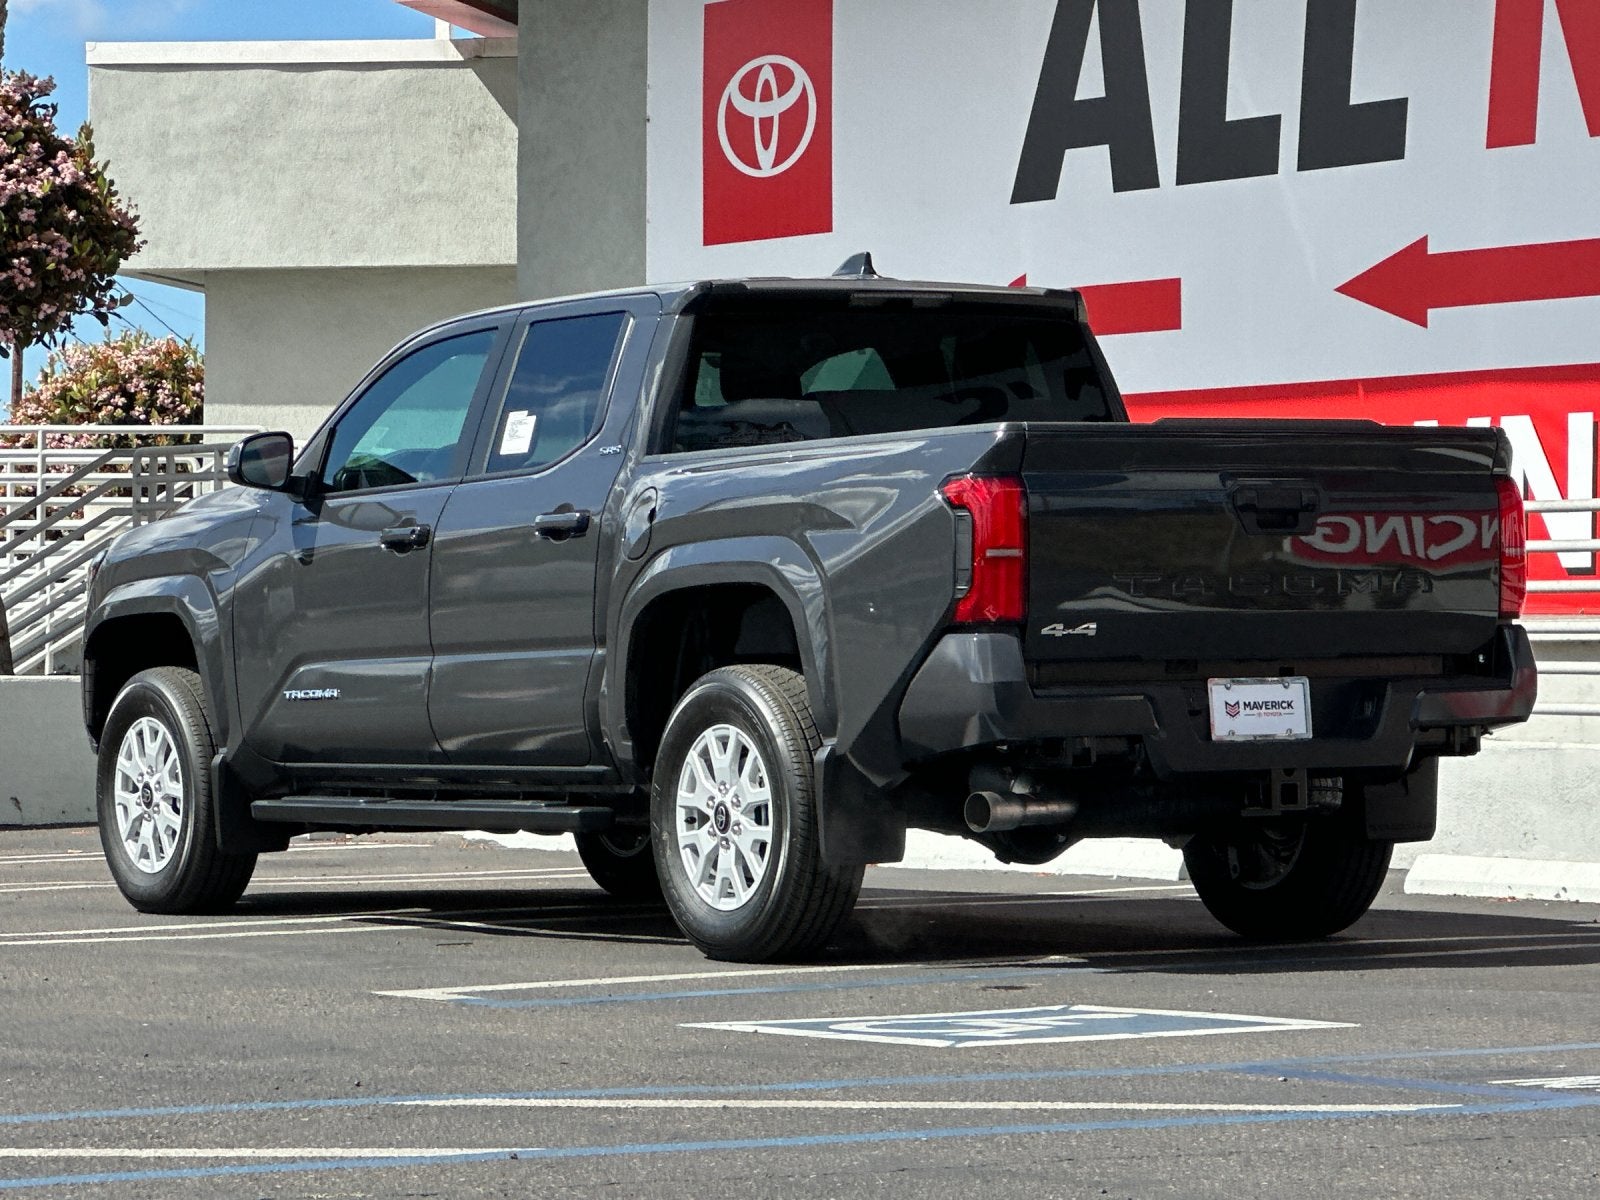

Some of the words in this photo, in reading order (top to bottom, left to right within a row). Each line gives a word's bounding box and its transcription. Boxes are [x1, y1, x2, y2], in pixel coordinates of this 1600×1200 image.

[1011, 0, 1409, 204] ALL
[1112, 570, 1433, 597] TACOMA
[283, 688, 338, 699] TACOMA
[1243, 700, 1295, 711] MAVERICK
